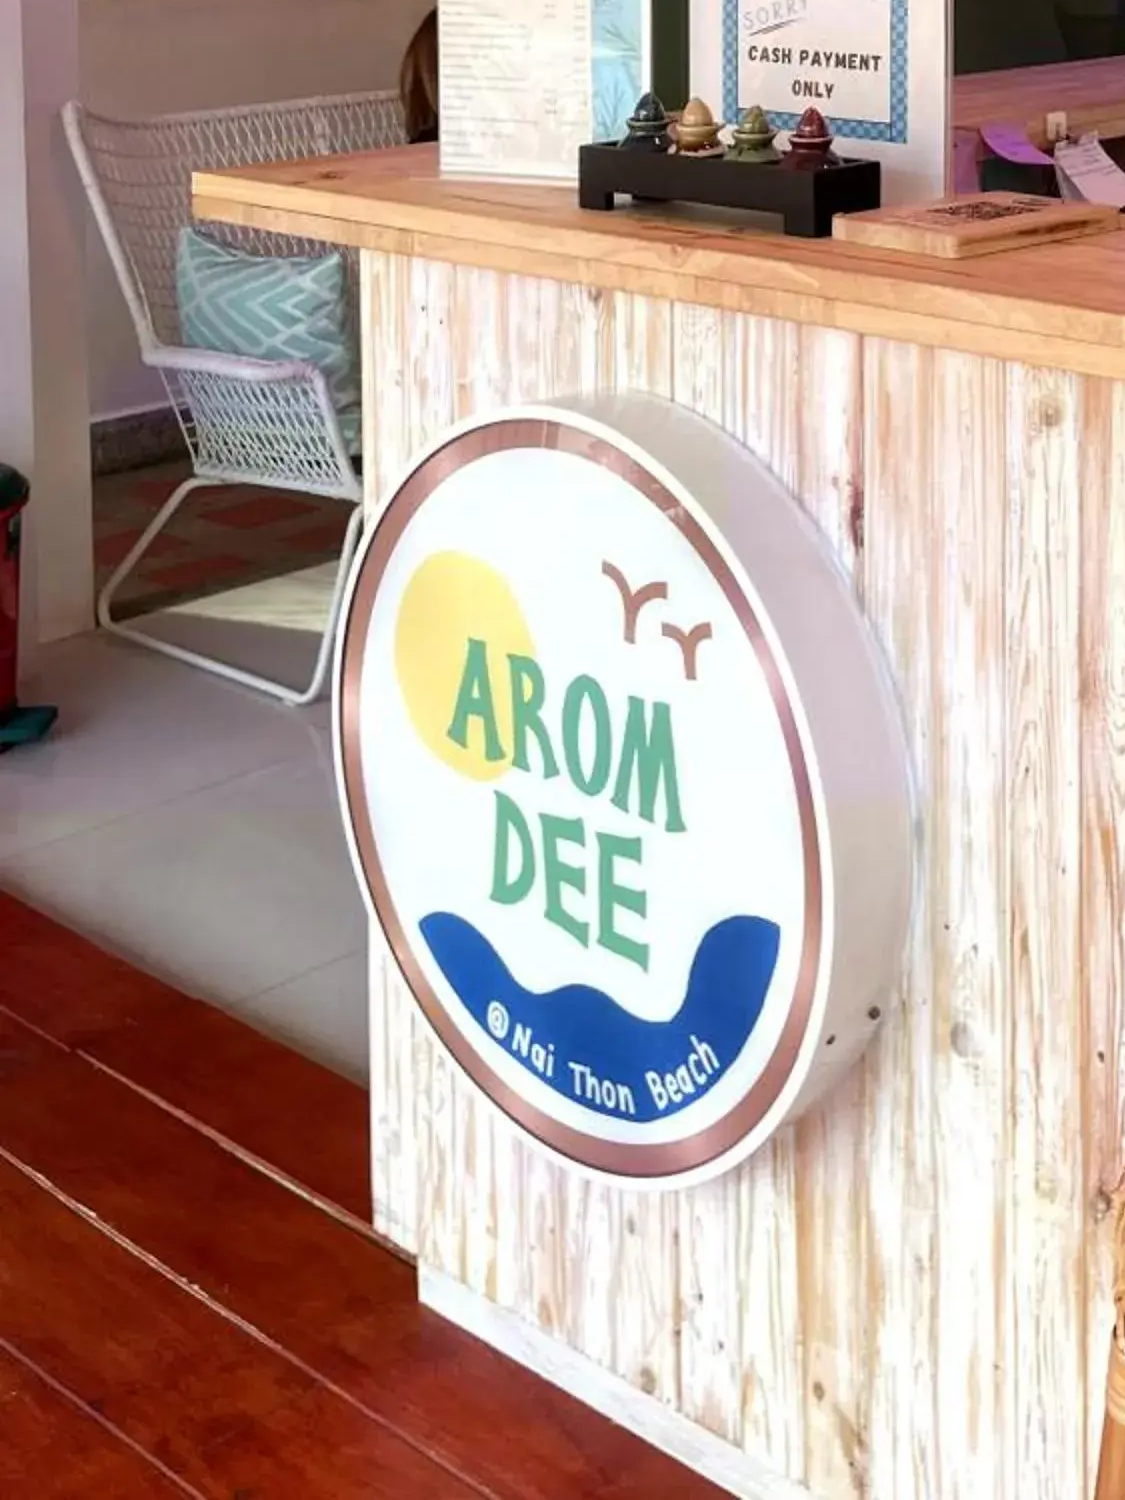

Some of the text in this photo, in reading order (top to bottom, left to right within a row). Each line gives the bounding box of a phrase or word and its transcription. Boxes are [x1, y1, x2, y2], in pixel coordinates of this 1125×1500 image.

[748, 46, 882, 71] CASH PAYMENT
[791, 79, 834, 99] ONLY
[446, 637, 687, 832] AROM
[489, 789, 649, 973] DEE
[568, 1061, 635, 1115] Thon
[645, 1035, 720, 1110] Beach
